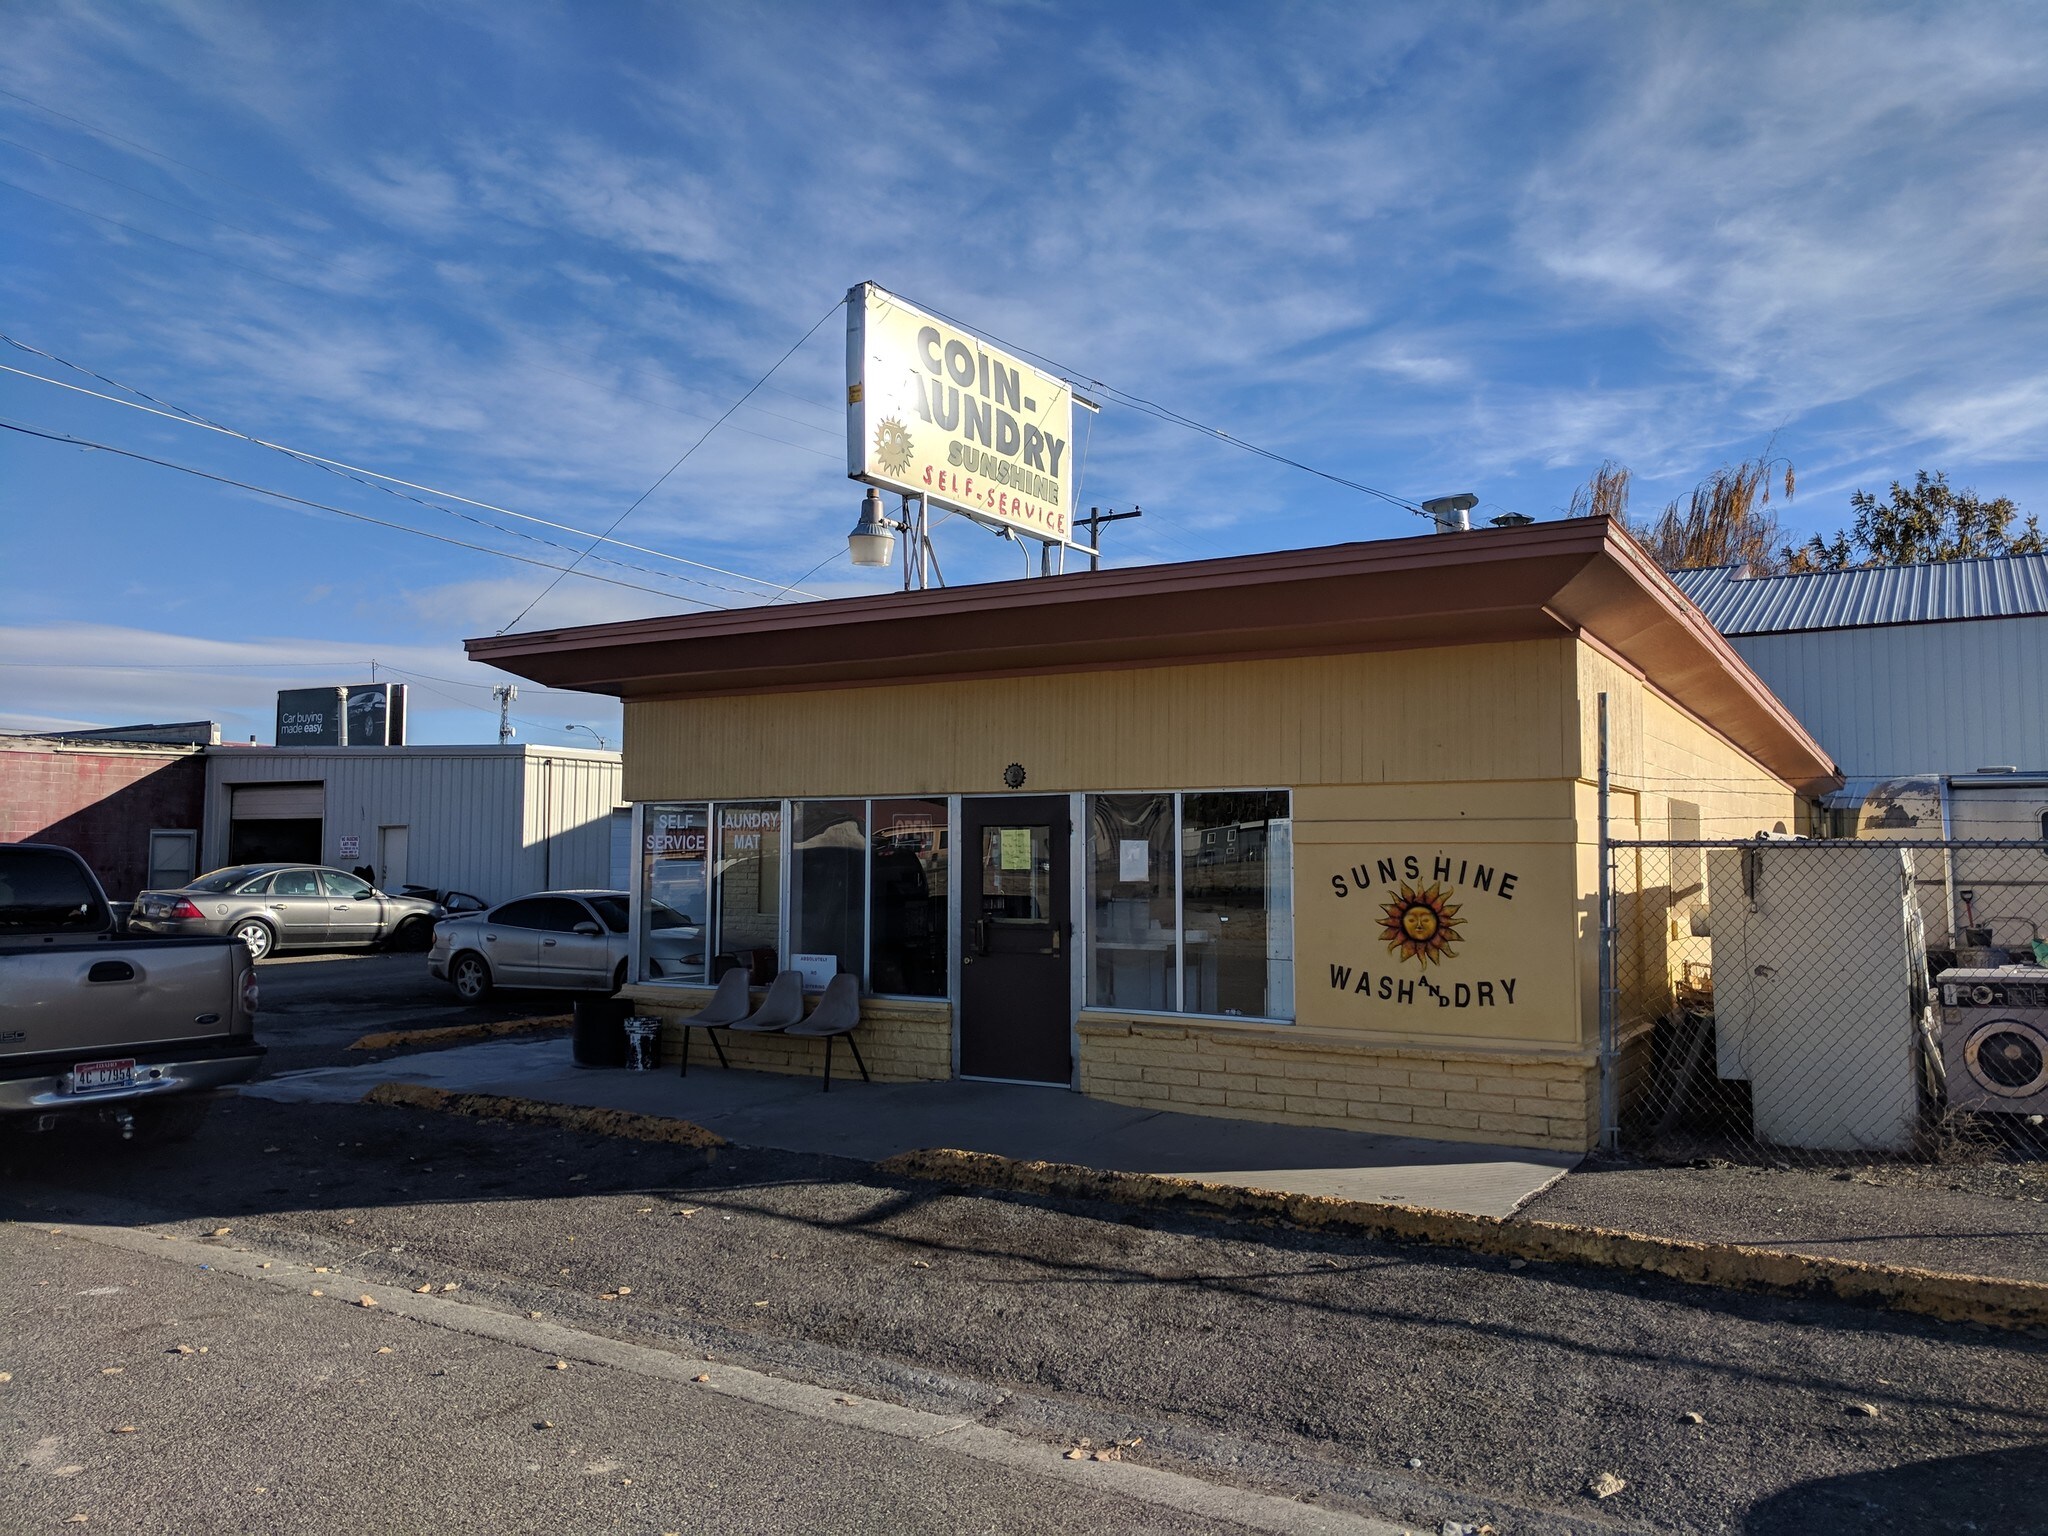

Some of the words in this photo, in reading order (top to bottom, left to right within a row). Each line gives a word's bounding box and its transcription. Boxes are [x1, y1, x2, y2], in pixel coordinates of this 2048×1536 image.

[917, 325, 1036, 413] COIN-
[908, 371, 1066, 479] AUNDRY
[947, 440, 1060, 506] SUNSHINE
[922, 464, 1066, 535] SELF-SERVICE
[282, 712, 296, 724] Car
[297, 711, 324, 724] buying
[281, 724, 302, 734] made
[303, 723, 324, 735] easy.
[658, 814, 694, 829] SELF
[717, 812, 780, 829] LAUNDRY
[895, 819, 931, 840] OPEN
[646, 834, 706, 850] SERVICE
[734, 834, 761, 849] MAT
[1331, 855, 1519, 900] SUNSHINE
[1330, 963, 1414, 1005] WASH
[1418, 975, 1450, 1007] AND
[1455, 978, 1516, 1008] DRY
[100, 1067, 131, 1083] C7954
